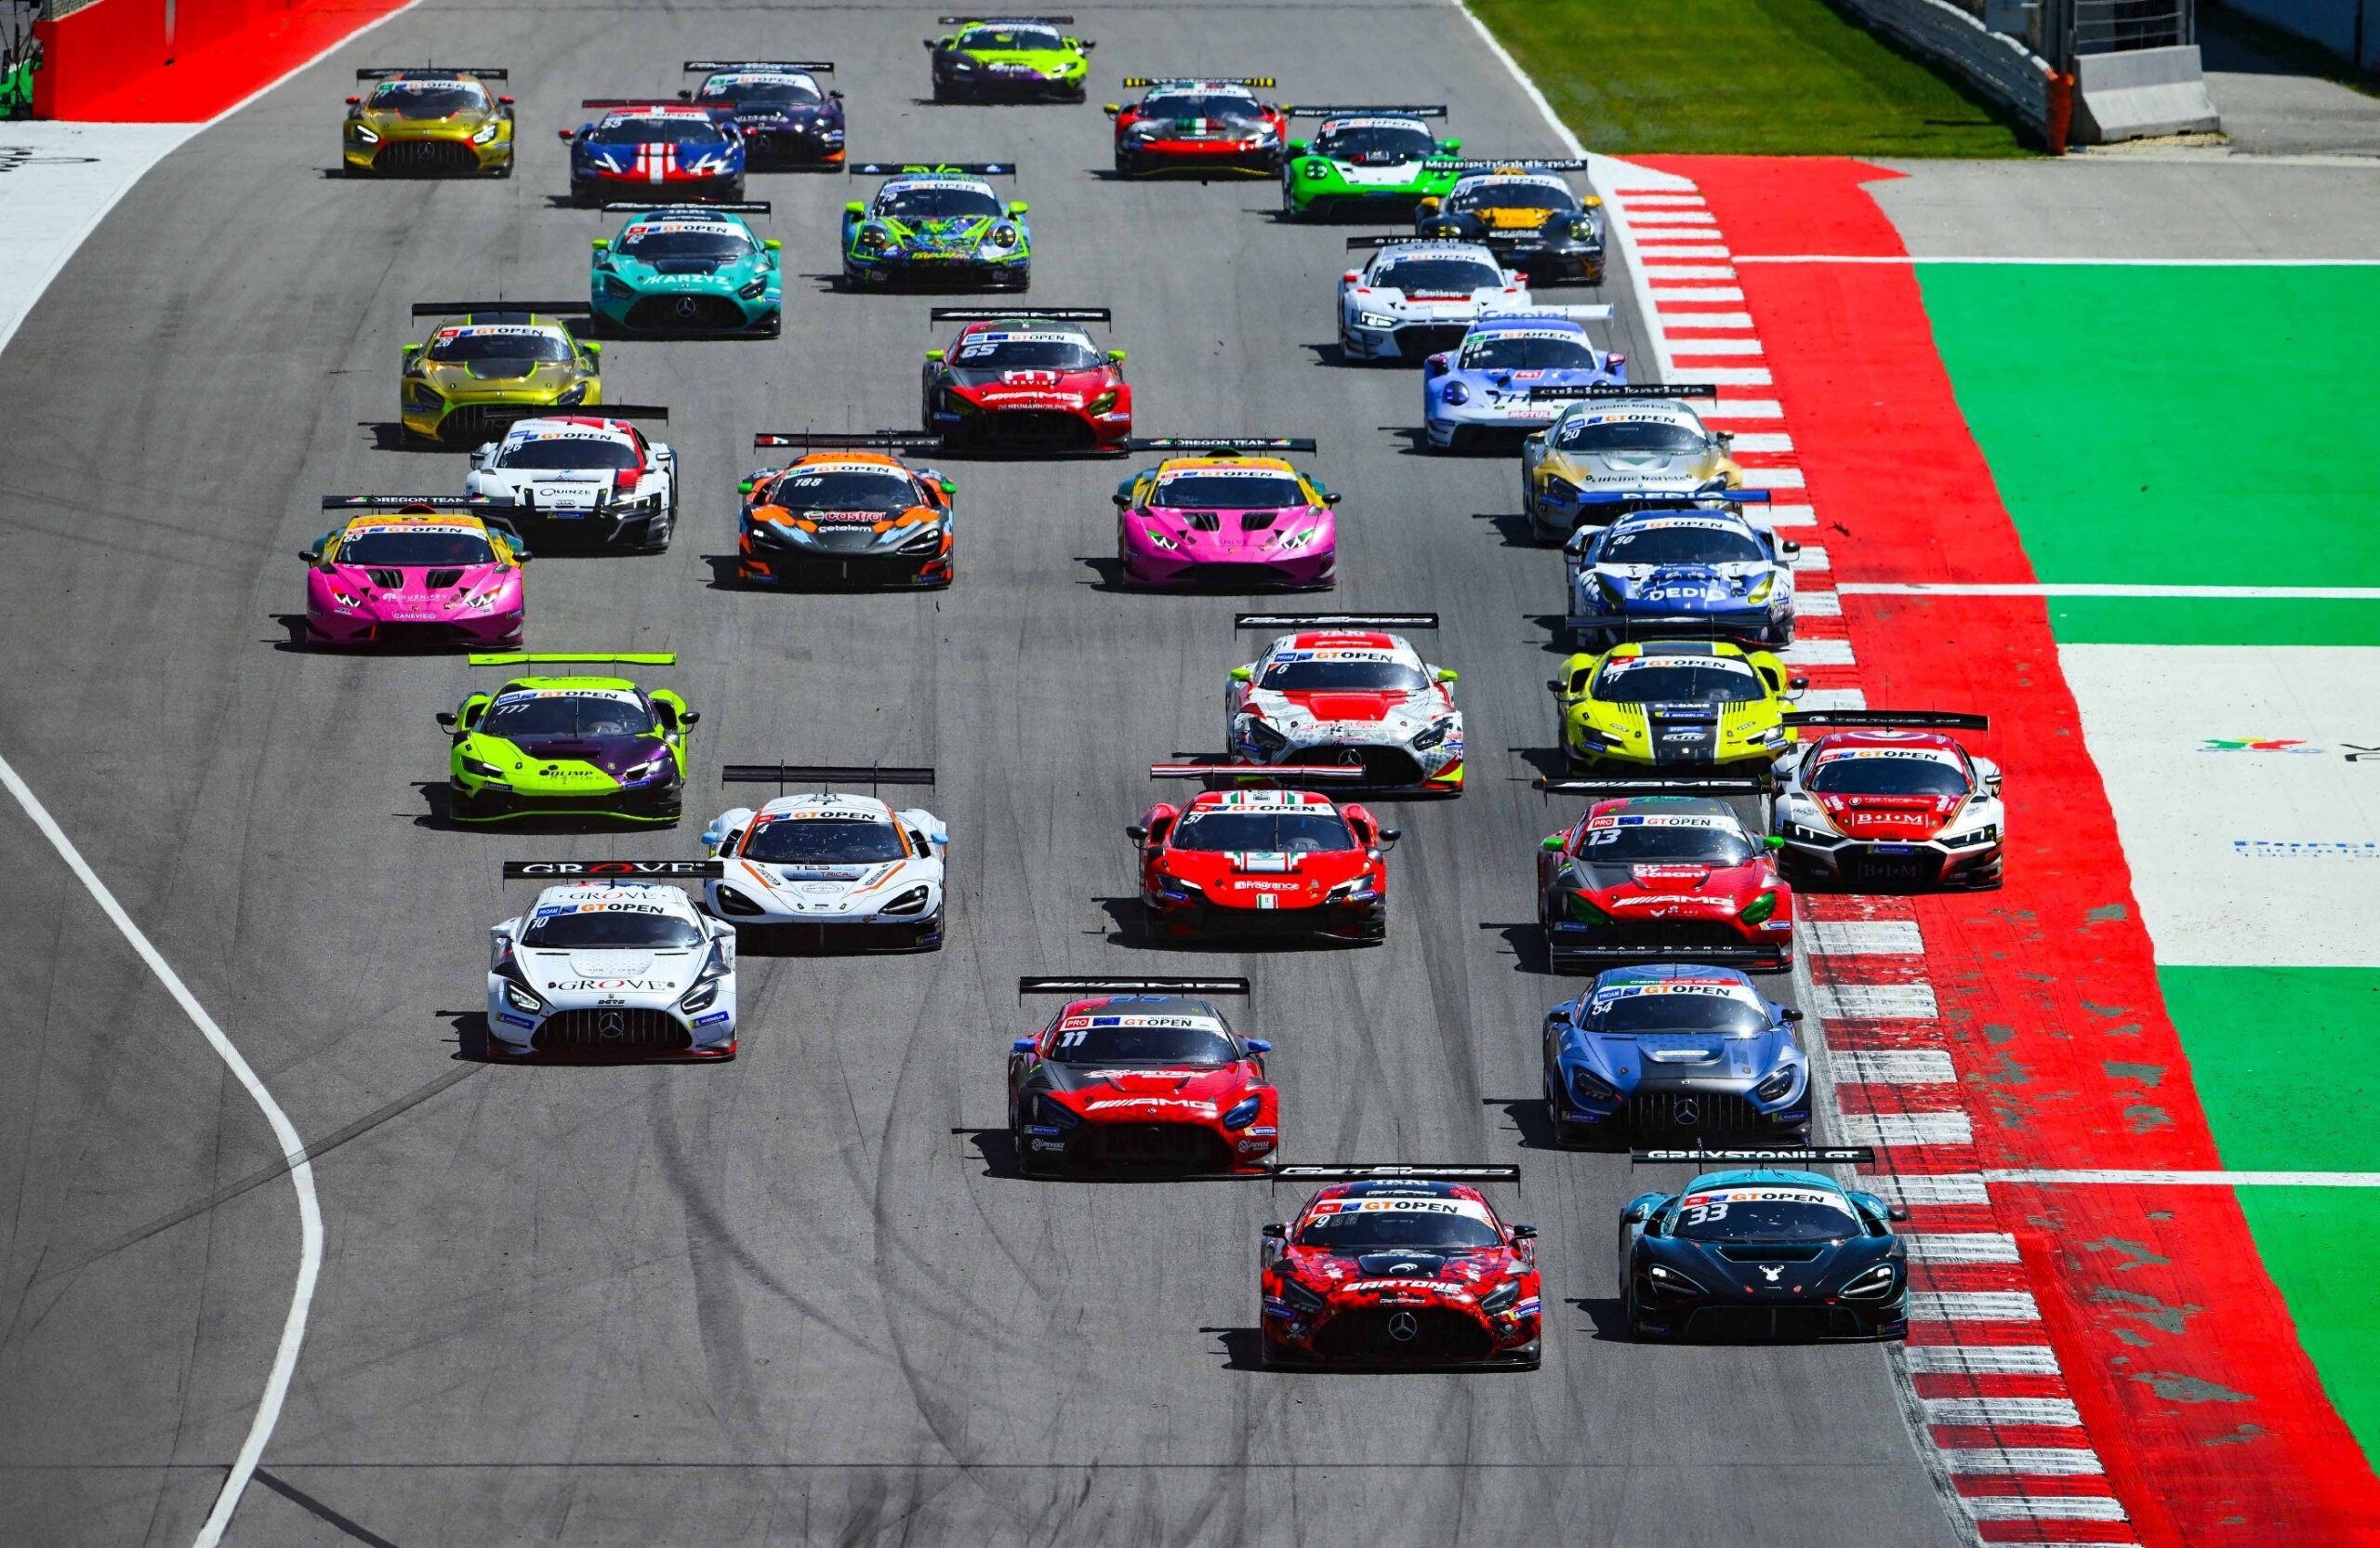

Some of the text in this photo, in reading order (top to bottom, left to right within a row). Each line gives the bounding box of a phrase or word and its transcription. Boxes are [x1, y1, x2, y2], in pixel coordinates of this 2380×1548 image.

[959, 343, 999, 359] 65
[1564, 430, 1580, 442] 20
[794, 477, 824, 488] 188
[1316, 651, 1394, 663] GTOPEN
[1277, 663, 1289, 674] 6
[540, 691, 618, 699] GTOPEN
[497, 704, 531, 716] 777
[1858, 750, 1938, 761] GTOPEN
[794, 811, 876, 821] GTOPEN
[1593, 817, 1711, 827] PRO GTOPEN
[758, 824, 769, 835] 4
[1585, 829, 1622, 846] 13
[1246, 880, 1301, 892] Fragrance
[569, 891, 657, 901] GROVE
[581, 903, 665, 914] GTOPEN
[531, 917, 550, 929] 10
[558, 979, 667, 991] GROVE
[1599, 986, 1731, 1001] PROAM GTOPEN
[1592, 1001, 1612, 1015] 54
[1067, 1018, 1193, 1027] PRO GTOPEN
[1060, 1030, 1089, 1048] 11
[1124, 1097, 1219, 1111] AMG
[1647, 1150, 1859, 1158] GREYSTONE GT
[1731, 1193, 1825, 1203] GTOPEN
[1364, 1200, 1459, 1214] GTOPEN
[1687, 1203, 1729, 1226] 33
[1315, 1214, 1328, 1228] 9
[1342, 1280, 1465, 1293] BARTONE
